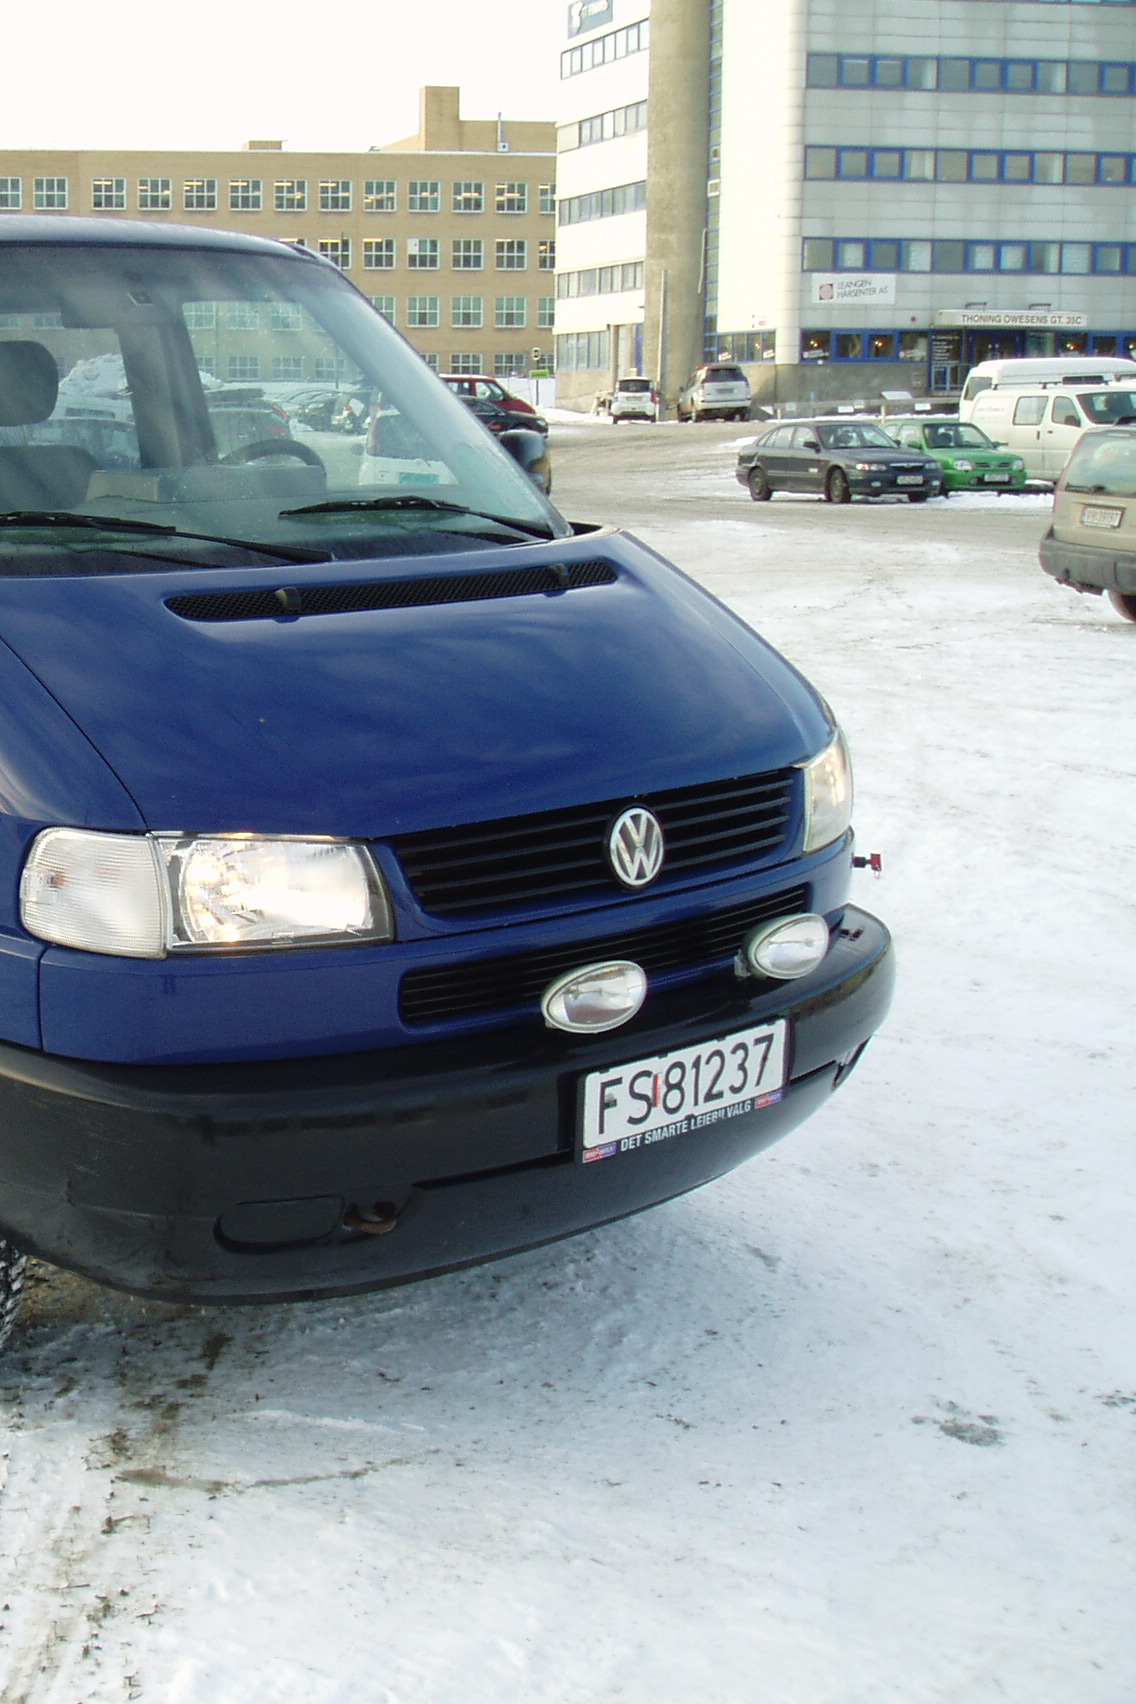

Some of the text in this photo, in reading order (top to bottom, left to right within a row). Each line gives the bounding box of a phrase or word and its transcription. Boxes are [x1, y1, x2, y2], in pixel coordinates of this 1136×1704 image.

[961, 314, 1002, 324] THONING
[1003, 314, 1048, 325] OWESENS
[1066, 316, 1082, 325] 35C
[620, 1133, 642, 1151] DET
[645, 1119, 688, 1145] SMARTE
